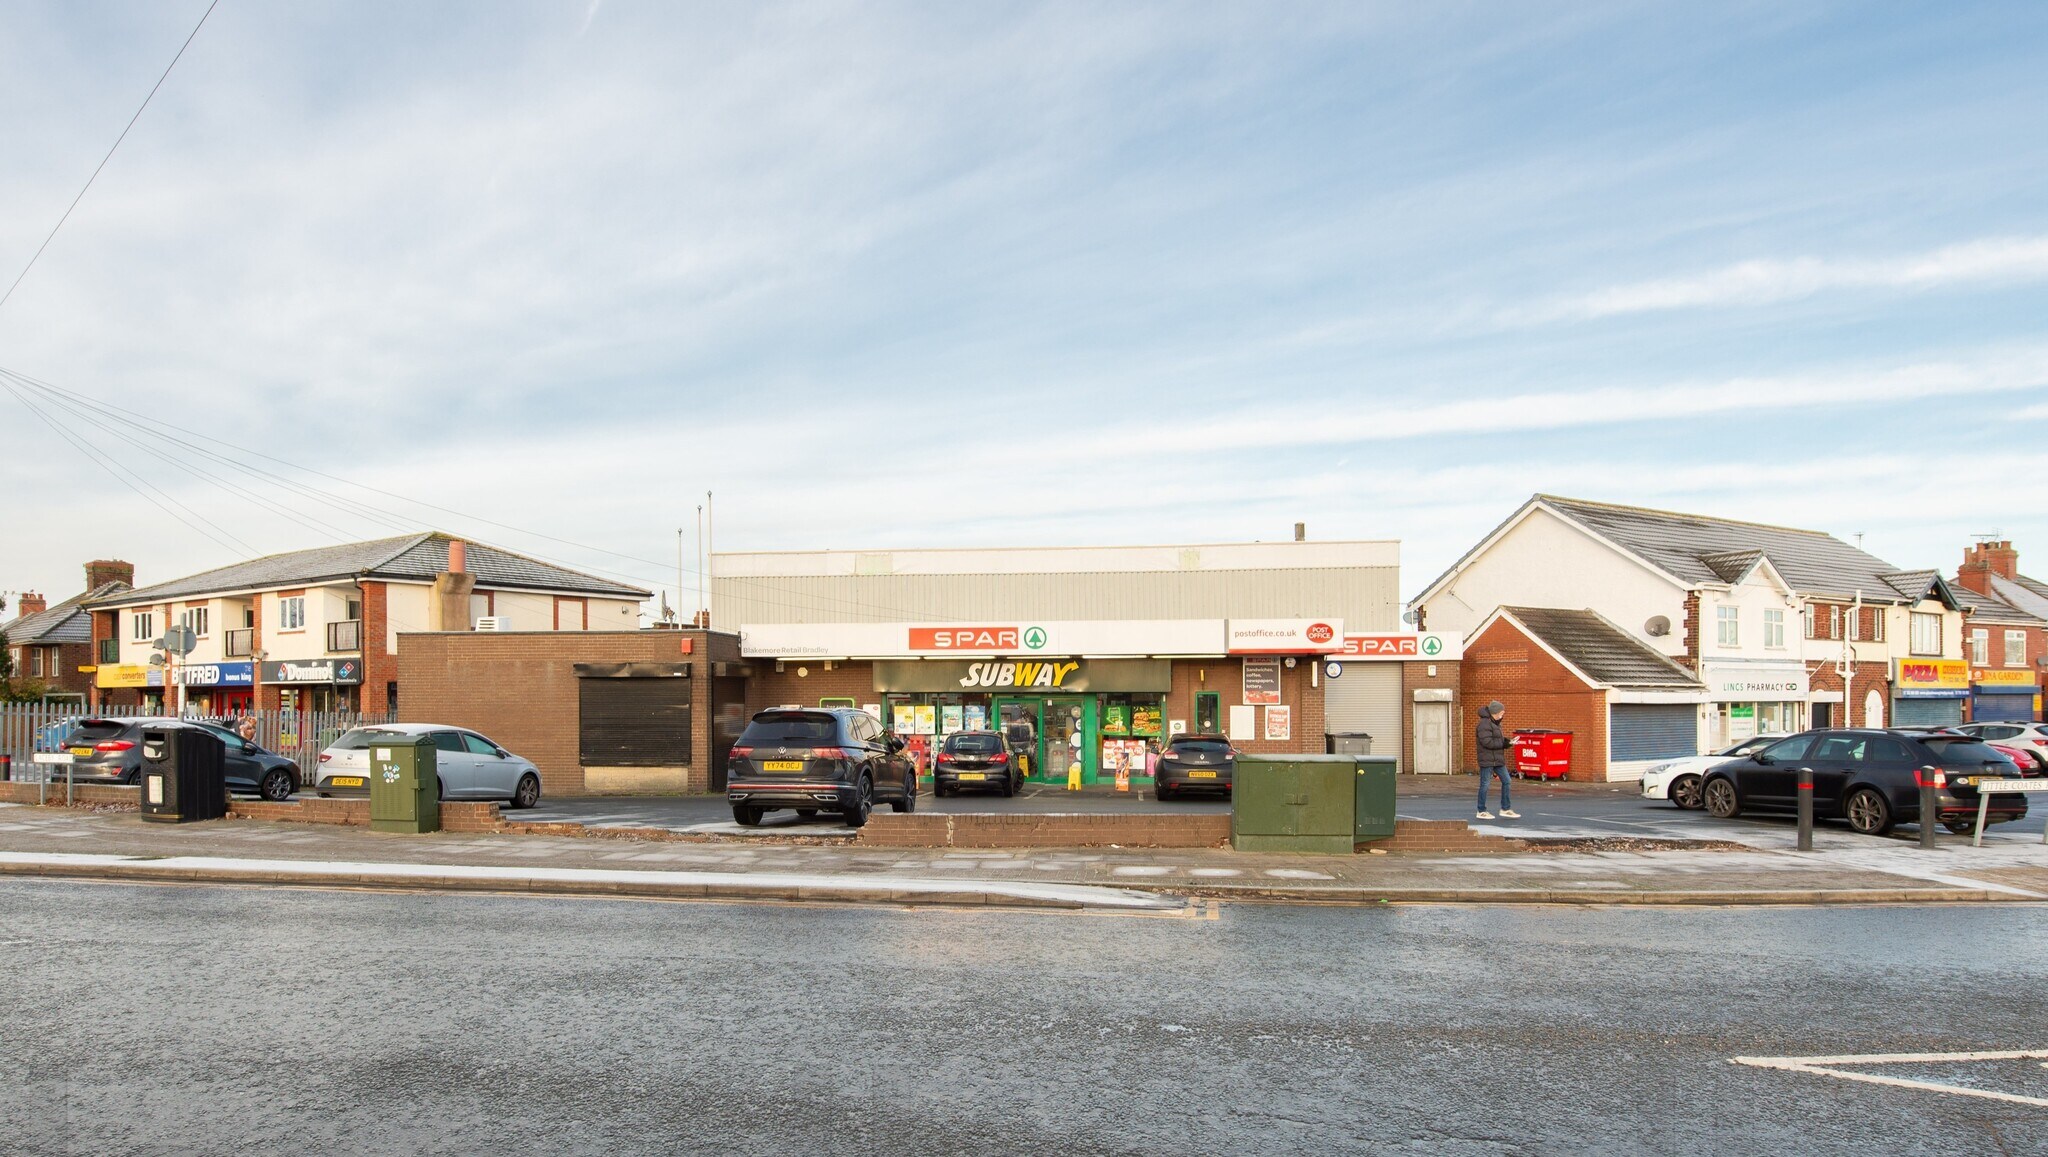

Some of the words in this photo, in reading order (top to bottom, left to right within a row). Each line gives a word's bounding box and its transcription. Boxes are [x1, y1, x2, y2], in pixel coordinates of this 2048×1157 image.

[1234, 629, 1297, 638] postoffice.co.uk
[1312, 626, 1329, 634] POST
[934, 631, 1017, 647] SPAR
[1343, 639, 1416, 653] SPAR
[171, 665, 219, 684] BTFRED
[241, 672, 252, 682] king
[959, 660, 1080, 688] SUBWAY
[1903, 664, 1939, 682] PIZZA
[1998, 671, 2024, 681] GARDEN
[1723, 683, 1744, 691] LINCS
[1746, 683, 1784, 691] PHARMACY
[1522, 748, 1537, 758] Biffa
[1982, 782, 2009, 791] LITTLE
[2011, 781, 2042, 790] COATES
